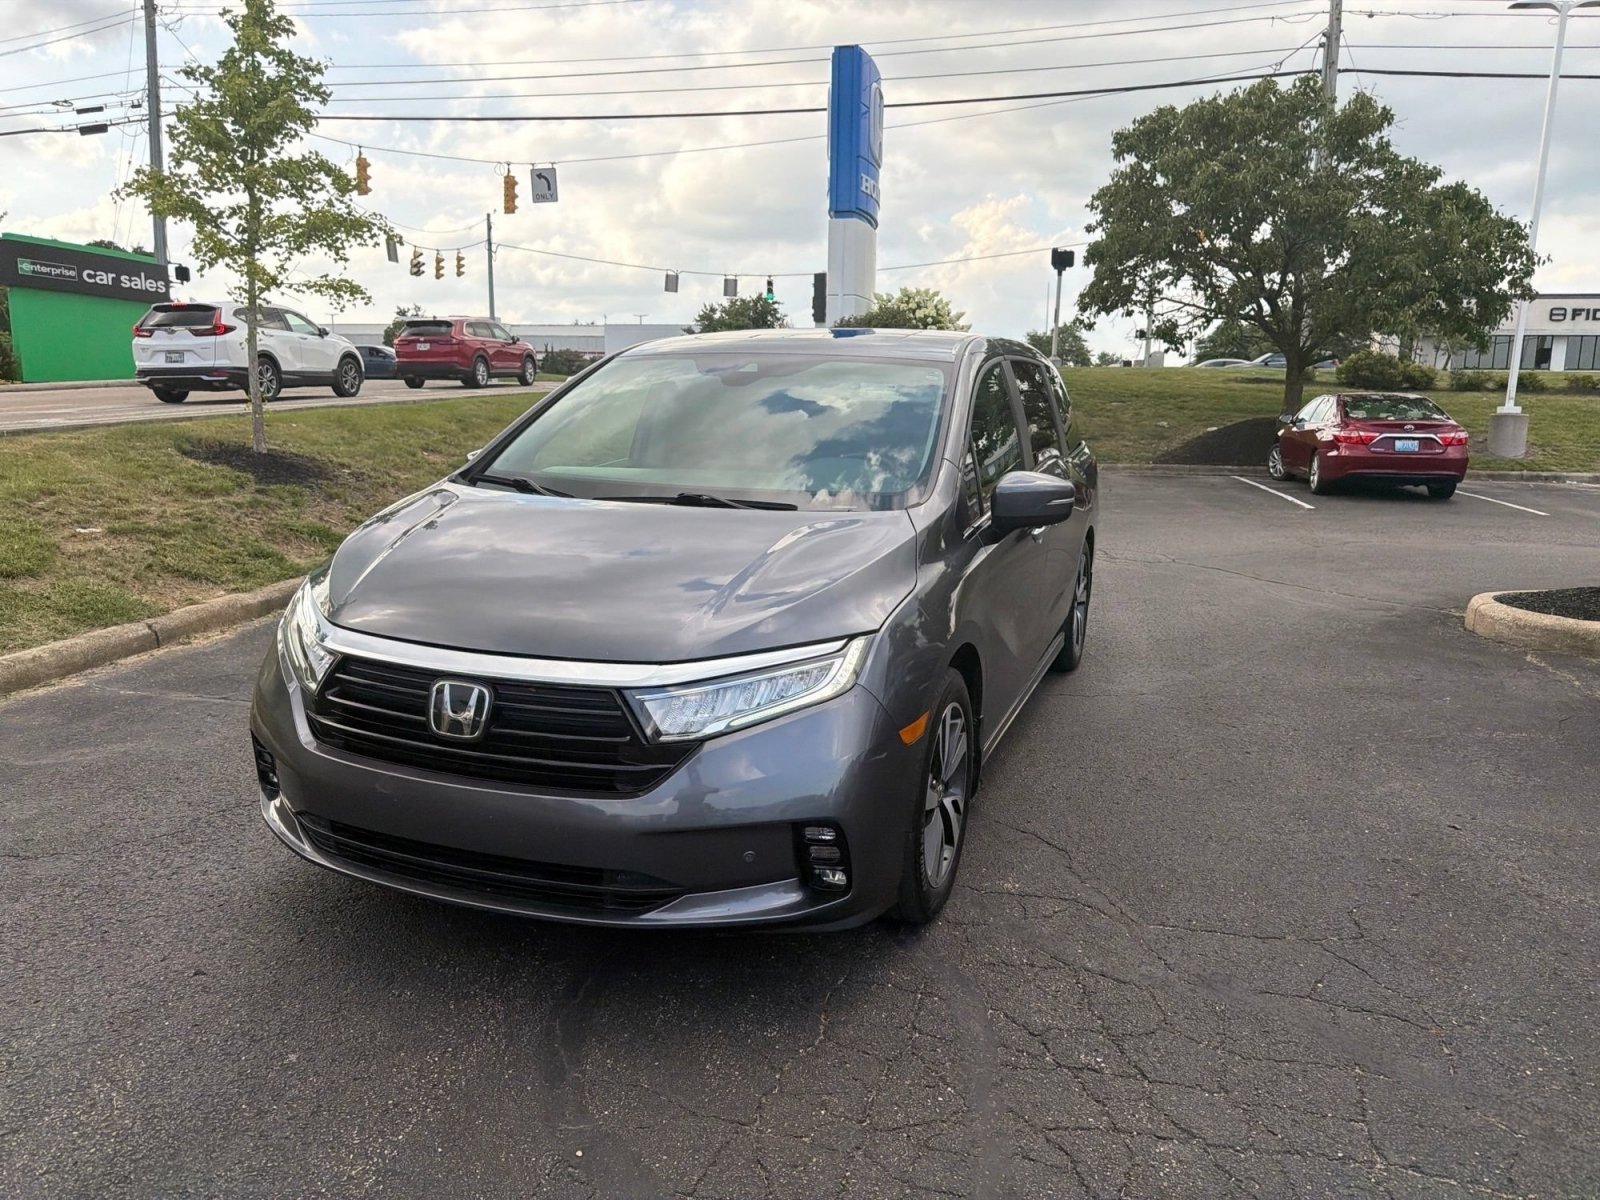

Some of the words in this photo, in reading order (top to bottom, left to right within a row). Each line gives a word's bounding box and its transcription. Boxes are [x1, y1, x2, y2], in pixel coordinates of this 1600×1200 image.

[535, 192, 554, 201] ONLY
[19, 261, 77, 277] enterprise
[82, 269, 116, 286] car
[120, 272, 167, 293] sales
